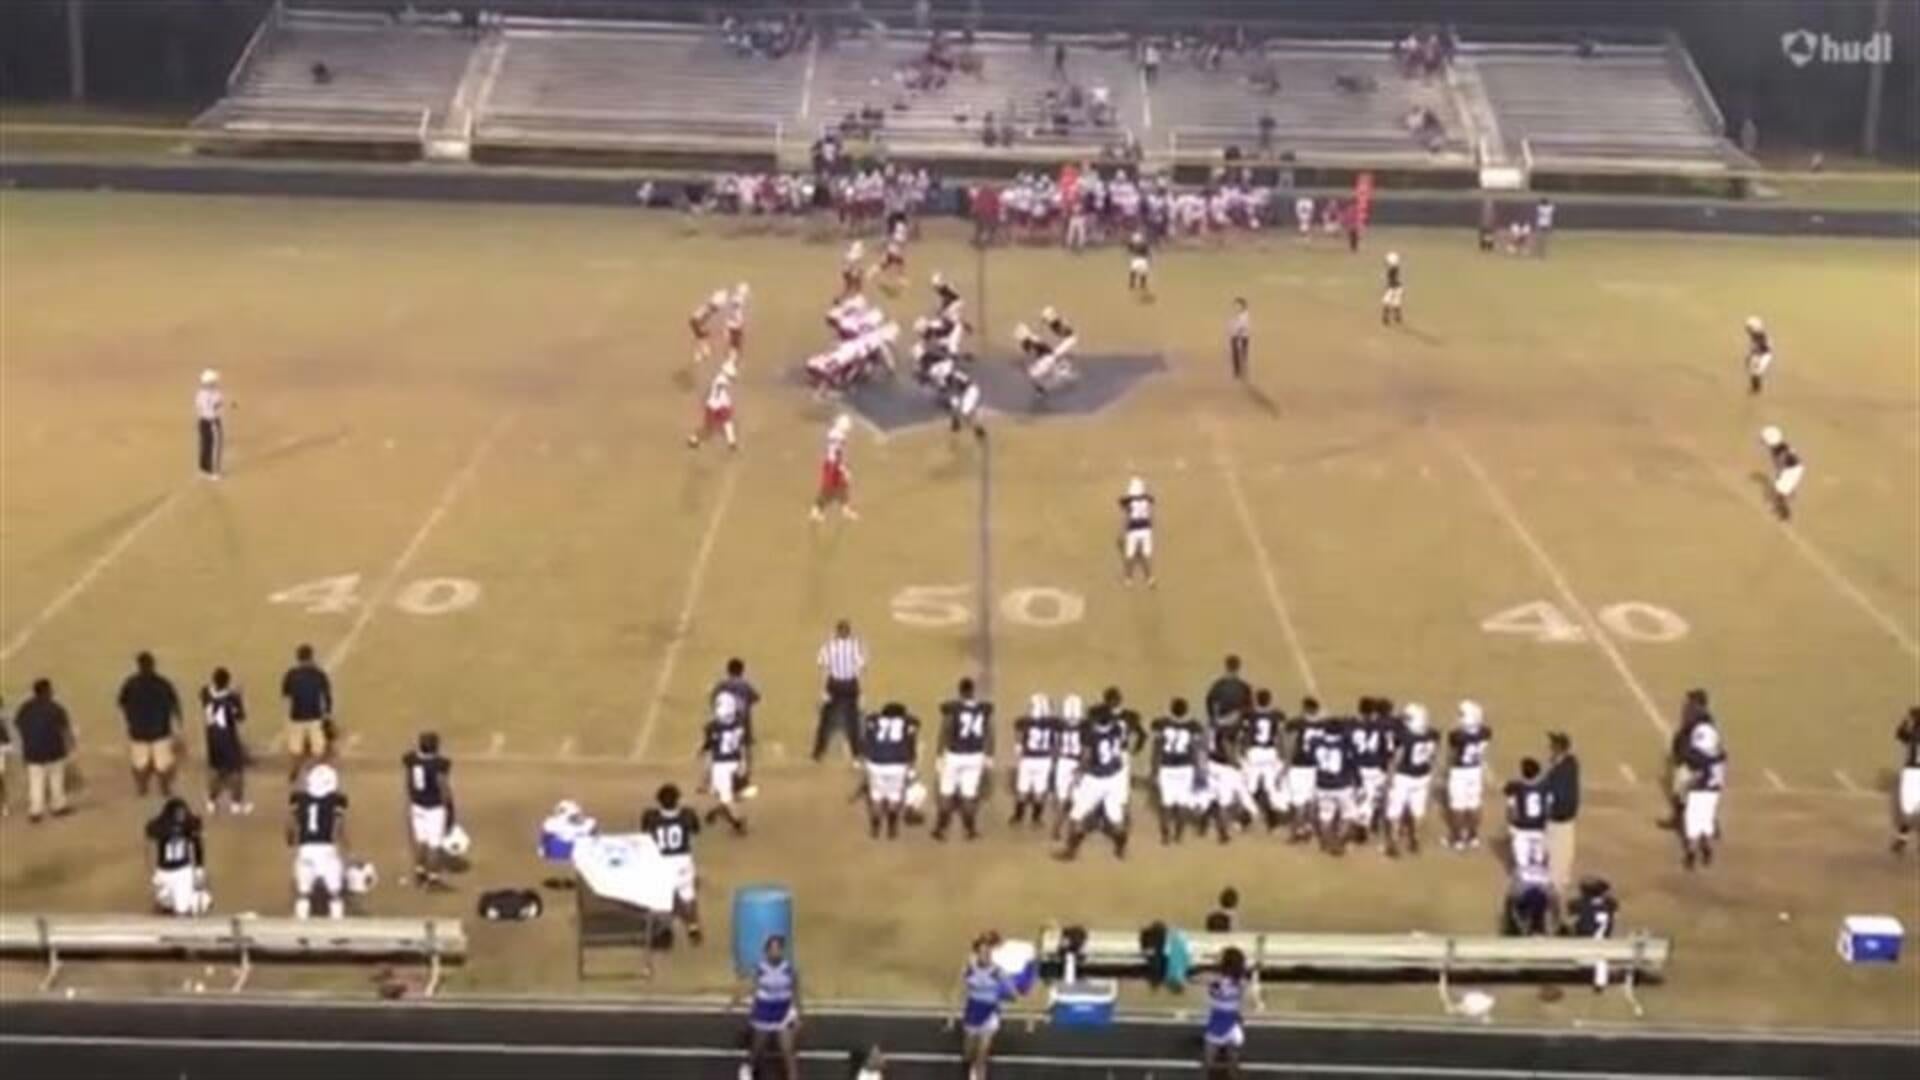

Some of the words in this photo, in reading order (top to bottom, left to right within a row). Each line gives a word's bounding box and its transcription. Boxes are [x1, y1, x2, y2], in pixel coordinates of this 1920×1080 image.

[268, 572, 481, 615] 40
[891, 585, 1086, 626] 50
[1481, 600, 1691, 642] 40
[959, 711, 984, 738] 74
[308, 803, 319, 831] 1
[656, 824, 683, 849] 10
